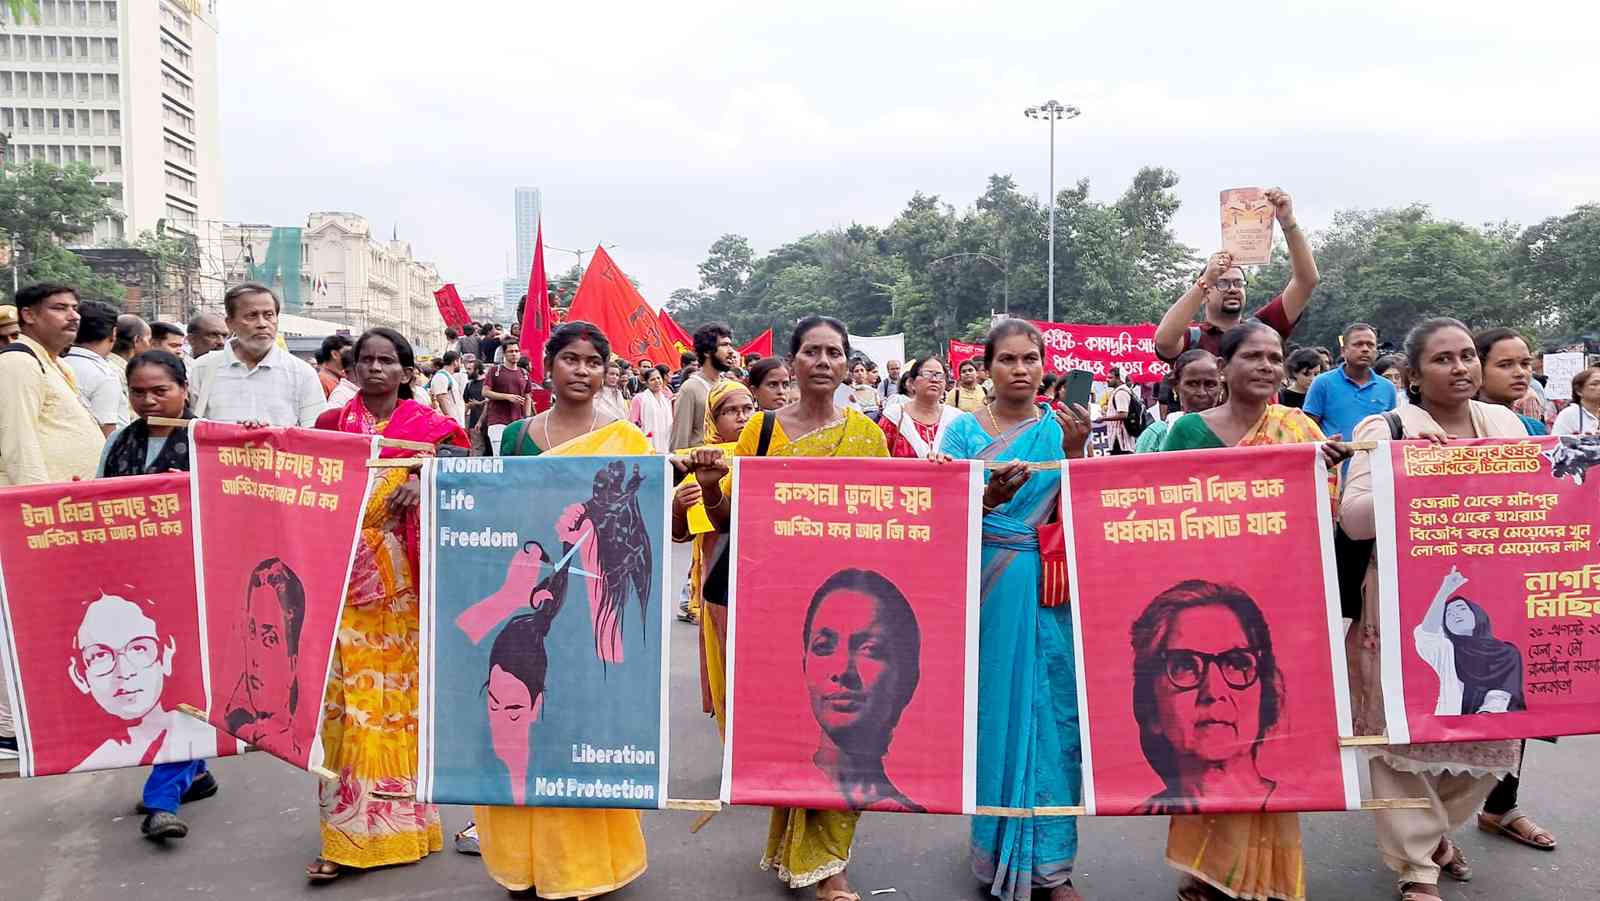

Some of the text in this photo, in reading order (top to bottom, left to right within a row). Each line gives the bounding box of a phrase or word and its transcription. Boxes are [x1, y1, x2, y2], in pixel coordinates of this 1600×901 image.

[441, 457, 504, 473] Women
[440, 489, 475, 510] Life
[774, 482, 932, 515] কল্পনা তুলছে স্বর
[1100, 475, 1286, 509] অরুণা আলী দিচ্ছে ডাক
[1409, 496, 1460, 509] গুজরাট
[1464, 496, 1503, 508] থেকে
[21, 493, 180, 527] ইলা মিত্র তুলছে স্বর
[1452, 511, 1491, 525] থেকে
[27, 518, 183, 549] জাস্টিস ফর আর জি কর
[774, 515, 931, 542] জাস্টিস ফর আর জি কর
[1104, 507, 1287, 544] ধর্ষকাম নিপাত যাক
[1409, 523, 1590, 541] বিজেপি করে মেয়েদের খুন
[440, 527, 519, 547] Freedom
[1410, 540, 1590, 558] লোপাট করে মেয়েদের লাশ
[571, 744, 656, 764] Liberation
[535, 776, 654, 799] Not Protection
